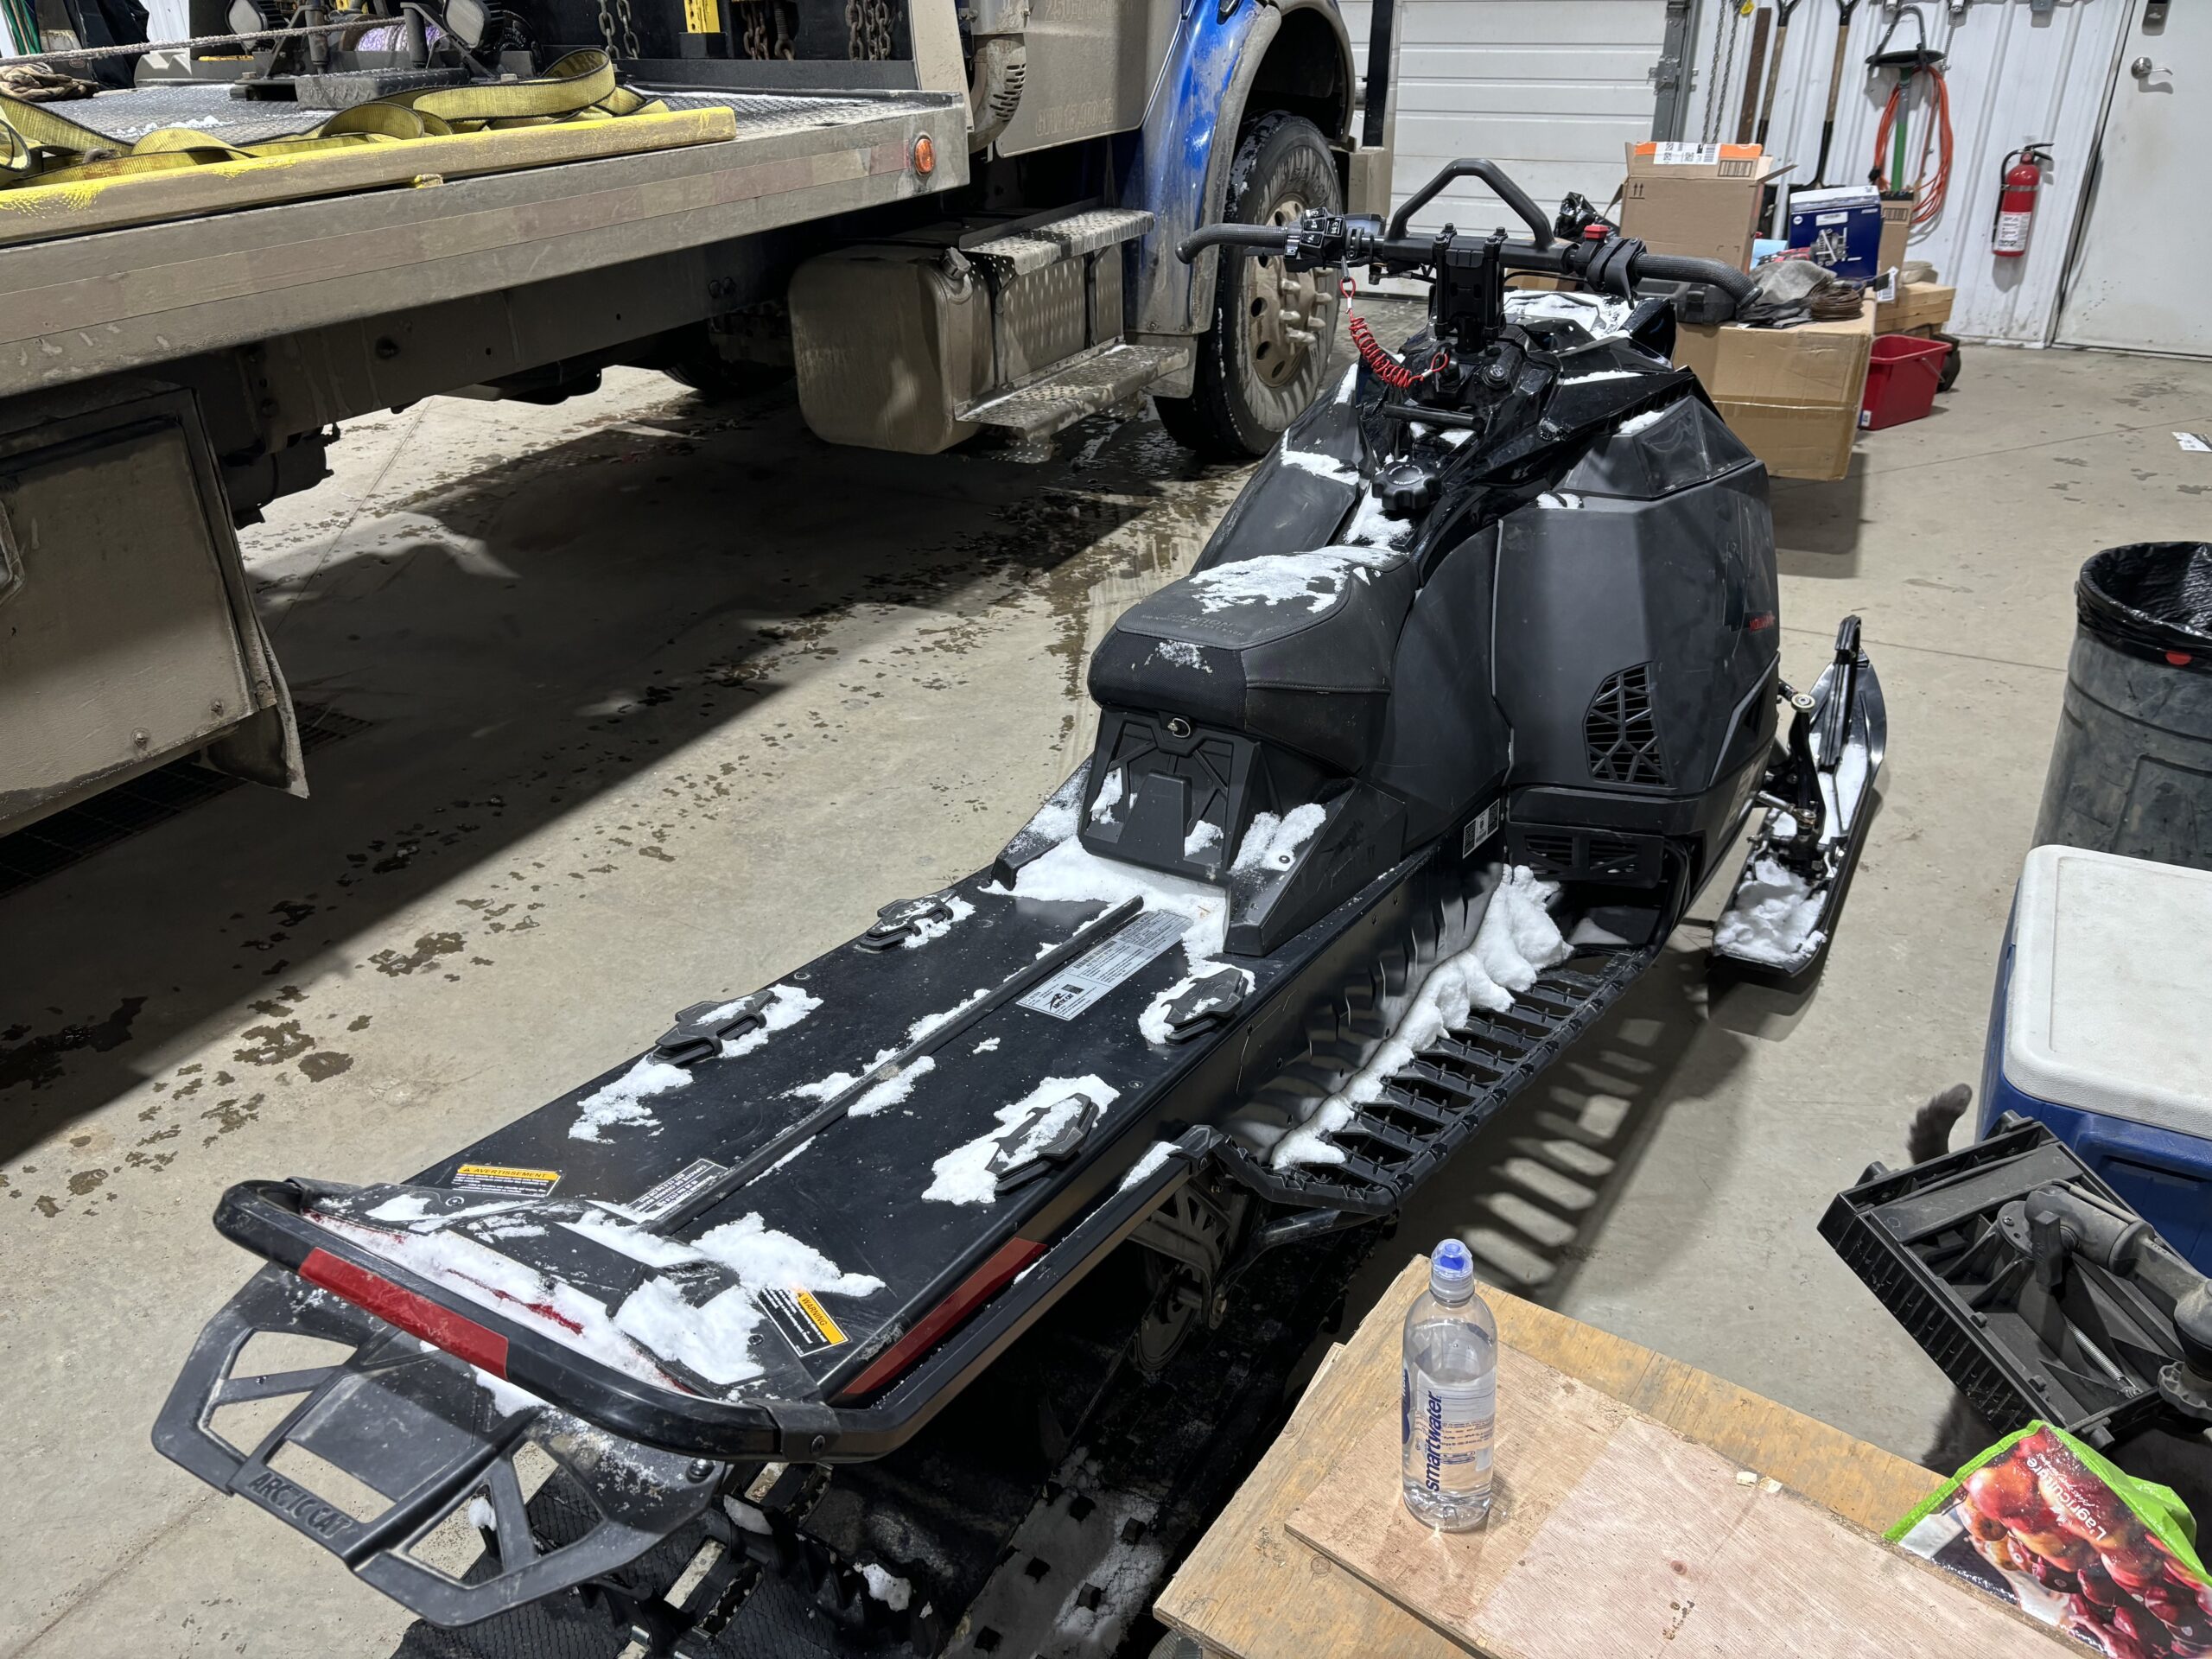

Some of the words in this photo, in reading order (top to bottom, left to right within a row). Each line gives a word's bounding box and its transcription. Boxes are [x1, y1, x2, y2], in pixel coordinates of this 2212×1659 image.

[474, 1168, 548, 1179] AVERTISSEMENT
[802, 1297, 828, 1326] WARNING
[1426, 1390, 1442, 1492] smartwater
[246, 1471, 315, 1518] ARCTIC
[306, 1507, 353, 1539] CAT
[2027, 1457, 2107, 1541] L'agriculture
